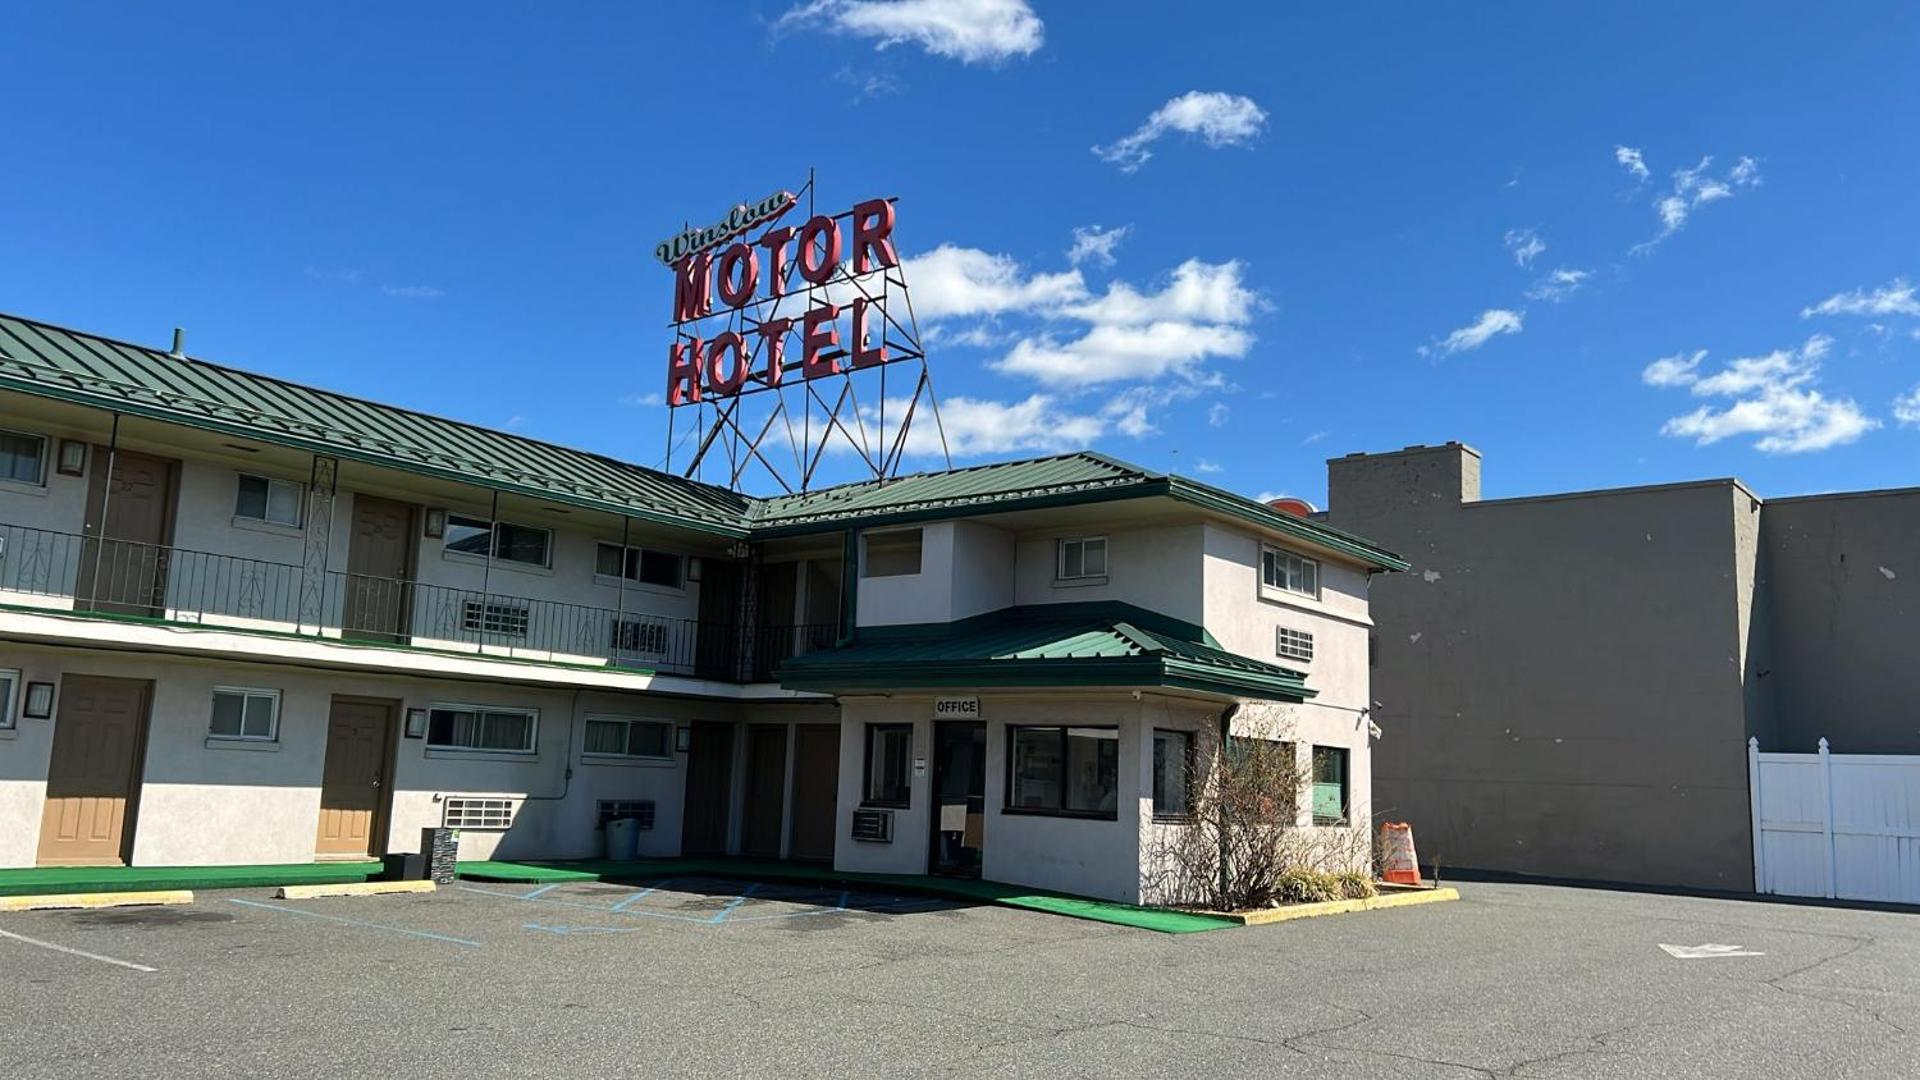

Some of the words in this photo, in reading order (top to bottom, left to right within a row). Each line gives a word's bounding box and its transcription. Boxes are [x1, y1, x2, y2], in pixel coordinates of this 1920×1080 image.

[657, 191, 795, 264] Winslow
[673, 199, 897, 322] MOTOR
[667, 297, 888, 406] HOTEL
[937, 700, 976, 713] OFFICE
